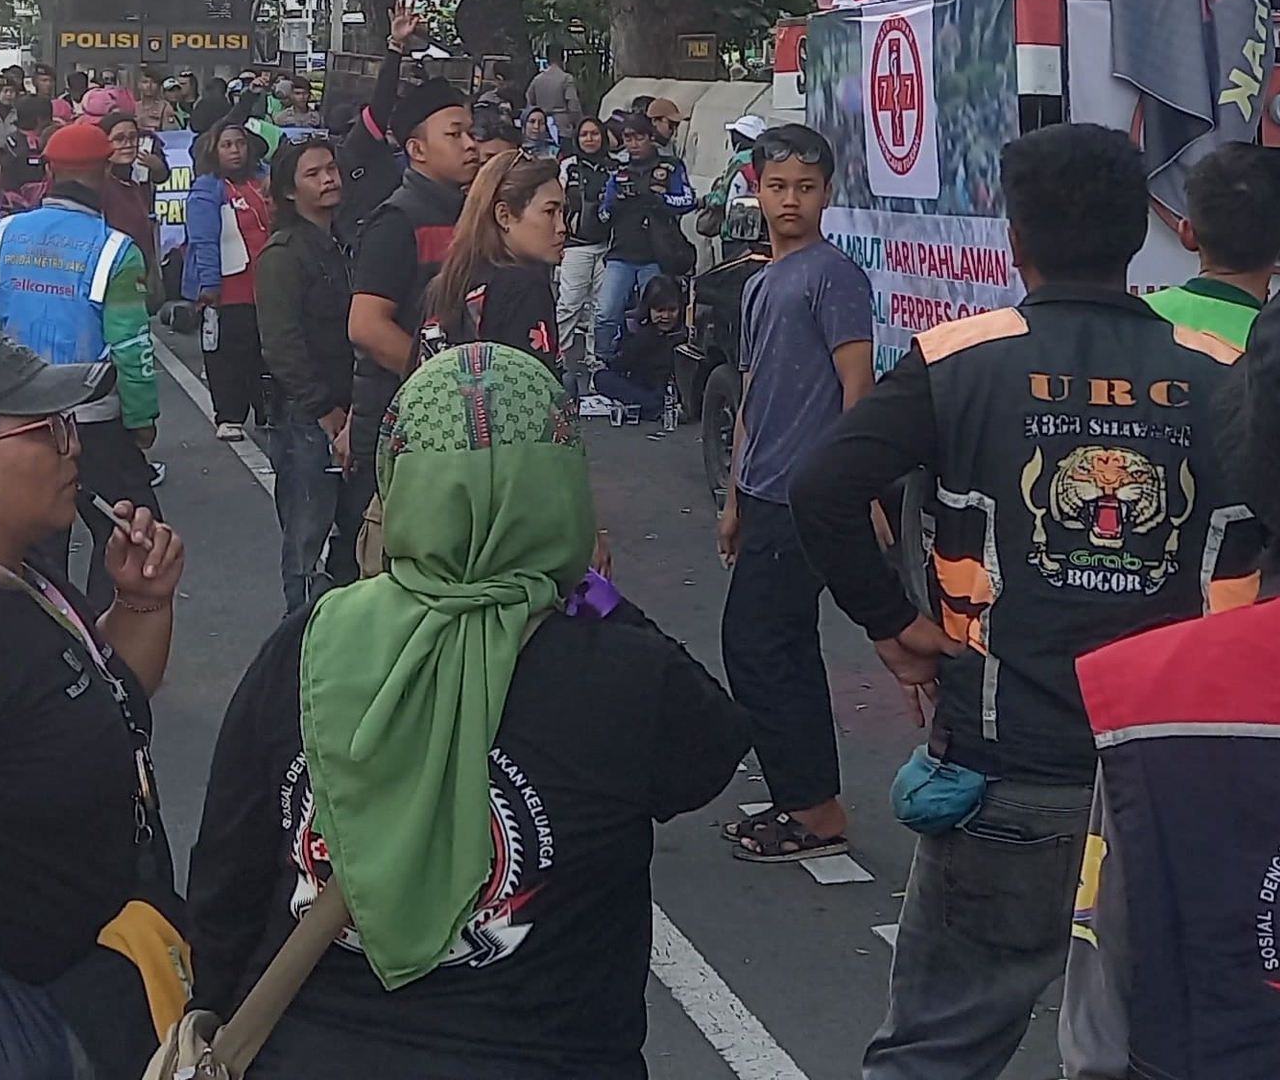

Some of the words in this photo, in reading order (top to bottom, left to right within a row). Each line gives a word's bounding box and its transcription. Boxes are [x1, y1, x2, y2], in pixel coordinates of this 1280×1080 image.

[60, 32, 140, 49] POLISI
[170, 33, 249, 50] POLISI
[884, 238, 916, 275] HARI
[918, 242, 1009, 288] PAHLAWAN
[1070, 550, 1143, 571] Grab
[1066, 568, 1143, 594] BOGOR
[285, 751, 308, 784] DEN
[520, 785, 555, 870] KELUARGA
[1258, 911, 1280, 971] SOSIAL
